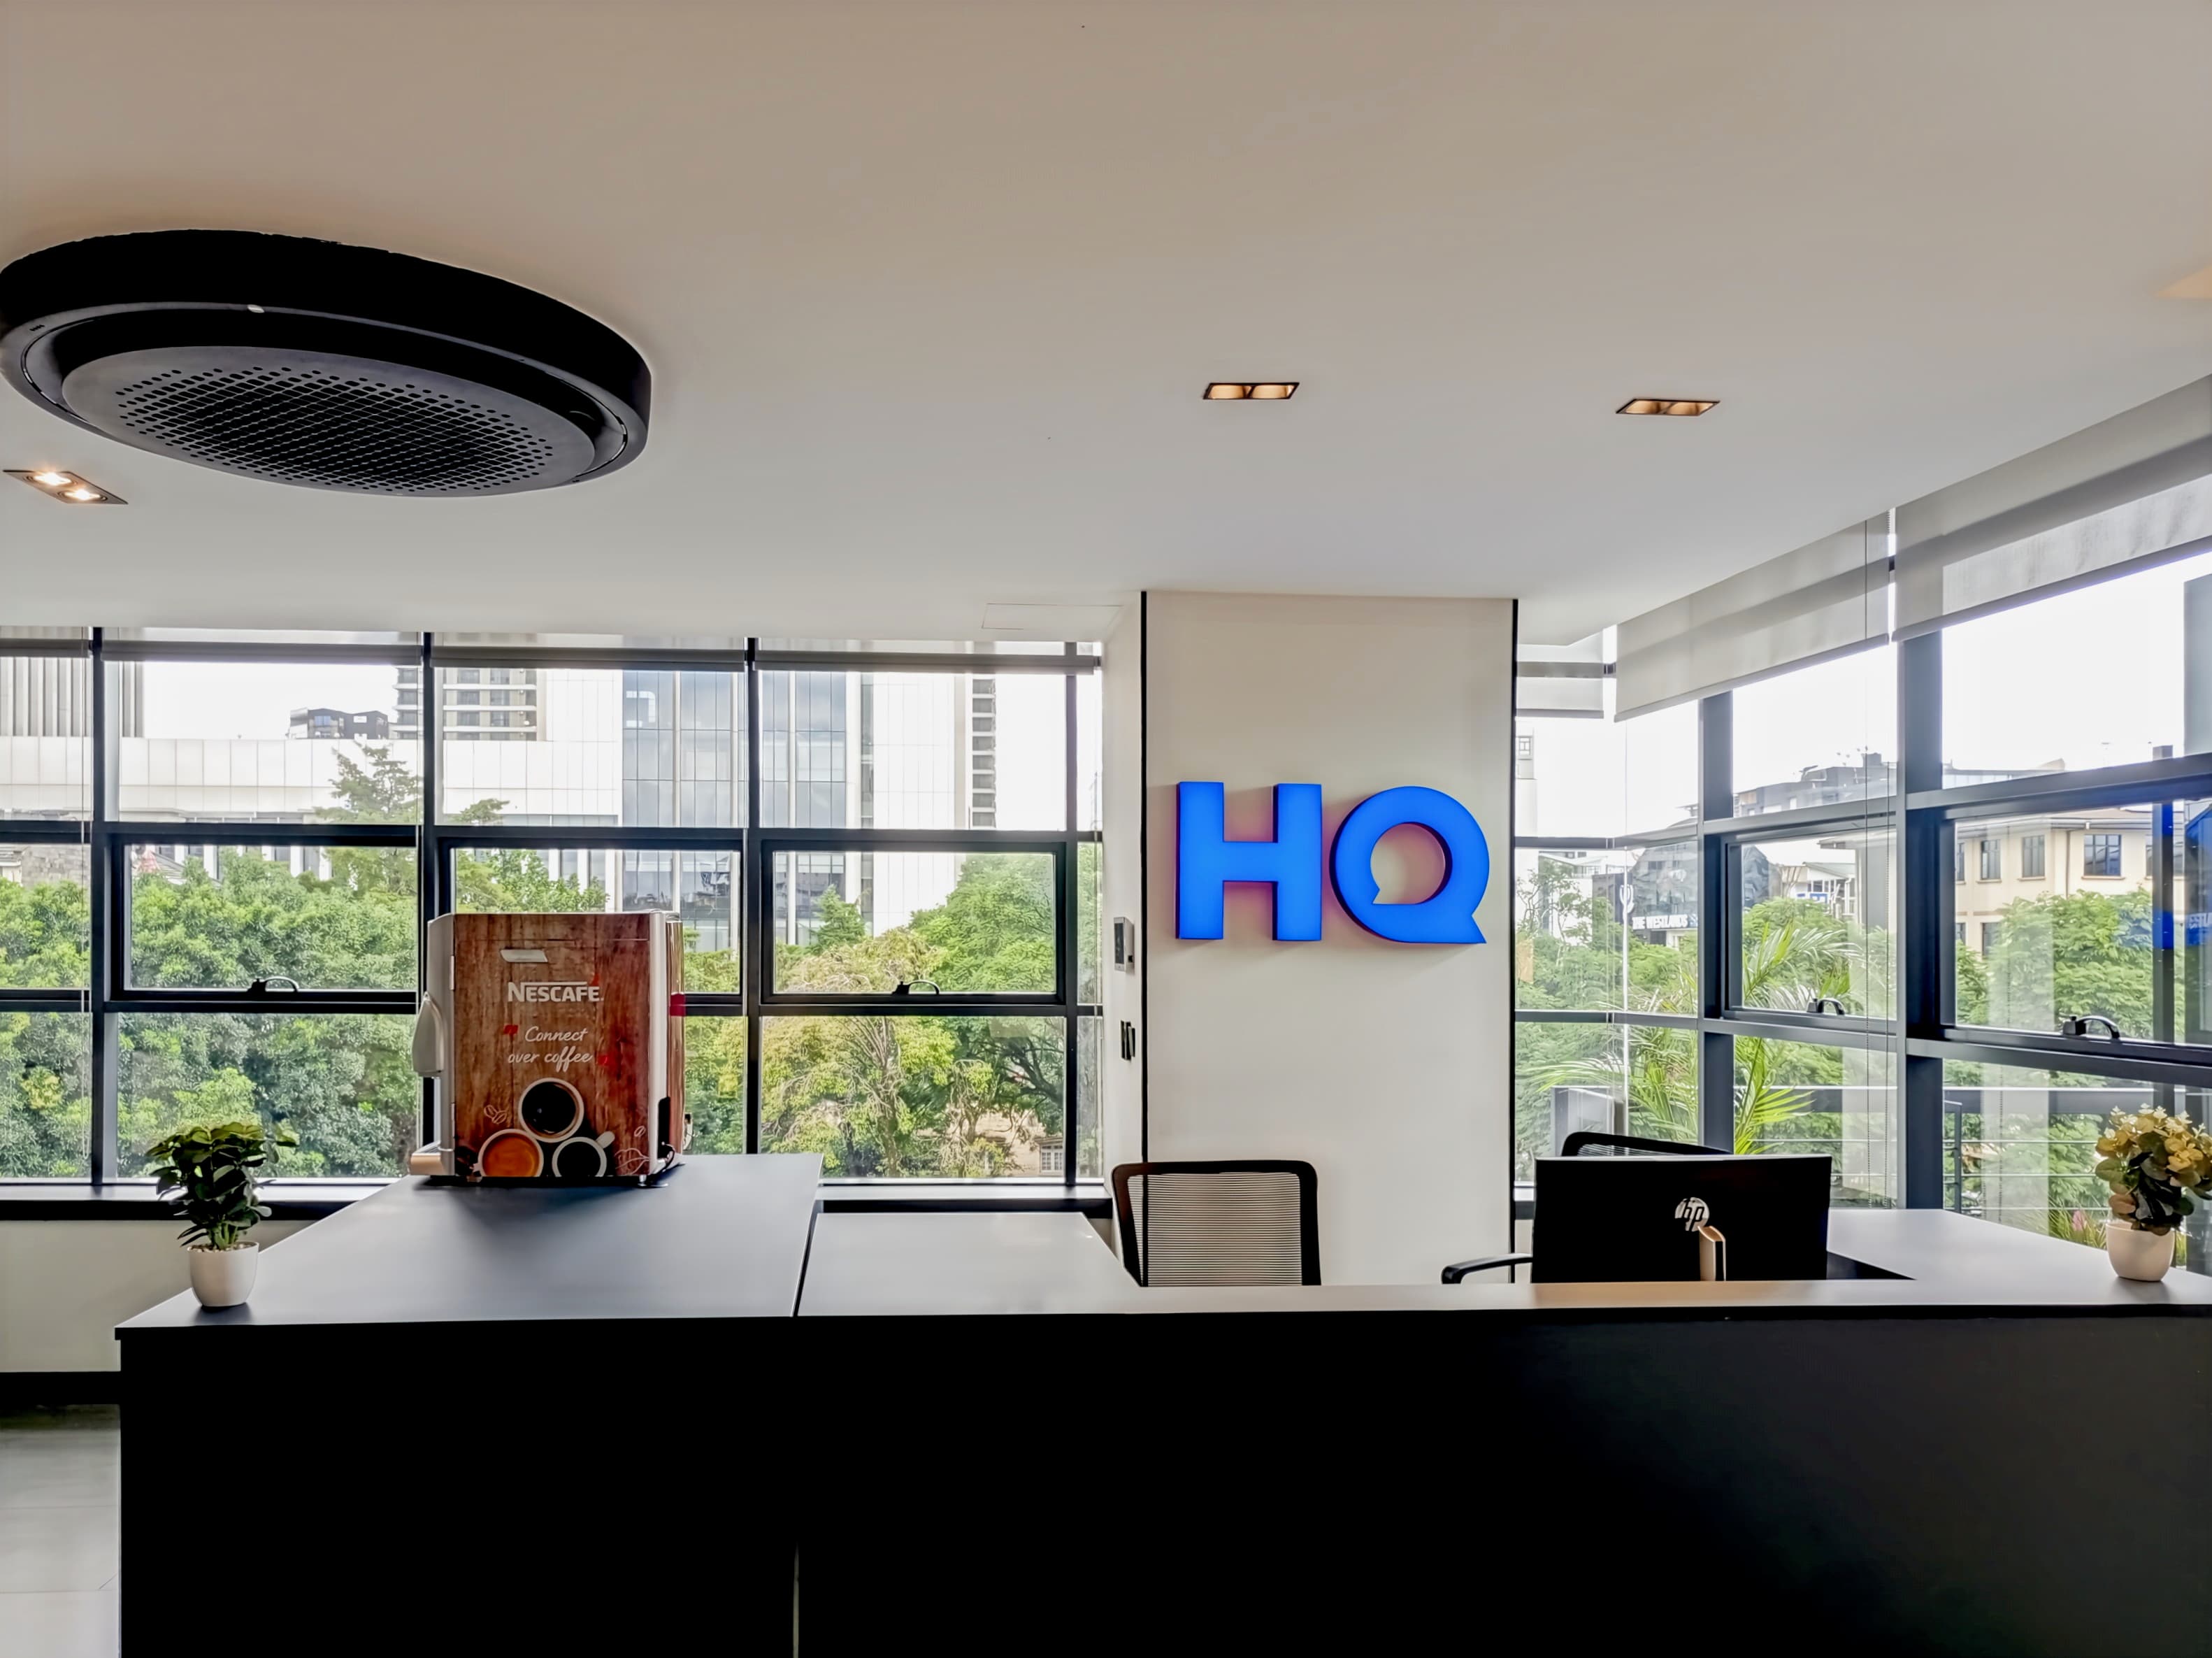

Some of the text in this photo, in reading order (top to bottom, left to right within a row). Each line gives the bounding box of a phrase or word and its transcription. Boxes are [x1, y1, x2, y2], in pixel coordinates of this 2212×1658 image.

[1176, 780, 1490, 944] HQ
[524, 1026, 588, 1042] Connect
[508, 1046, 593, 1073] over coffee
[1678, 1196, 1708, 1232] hp
